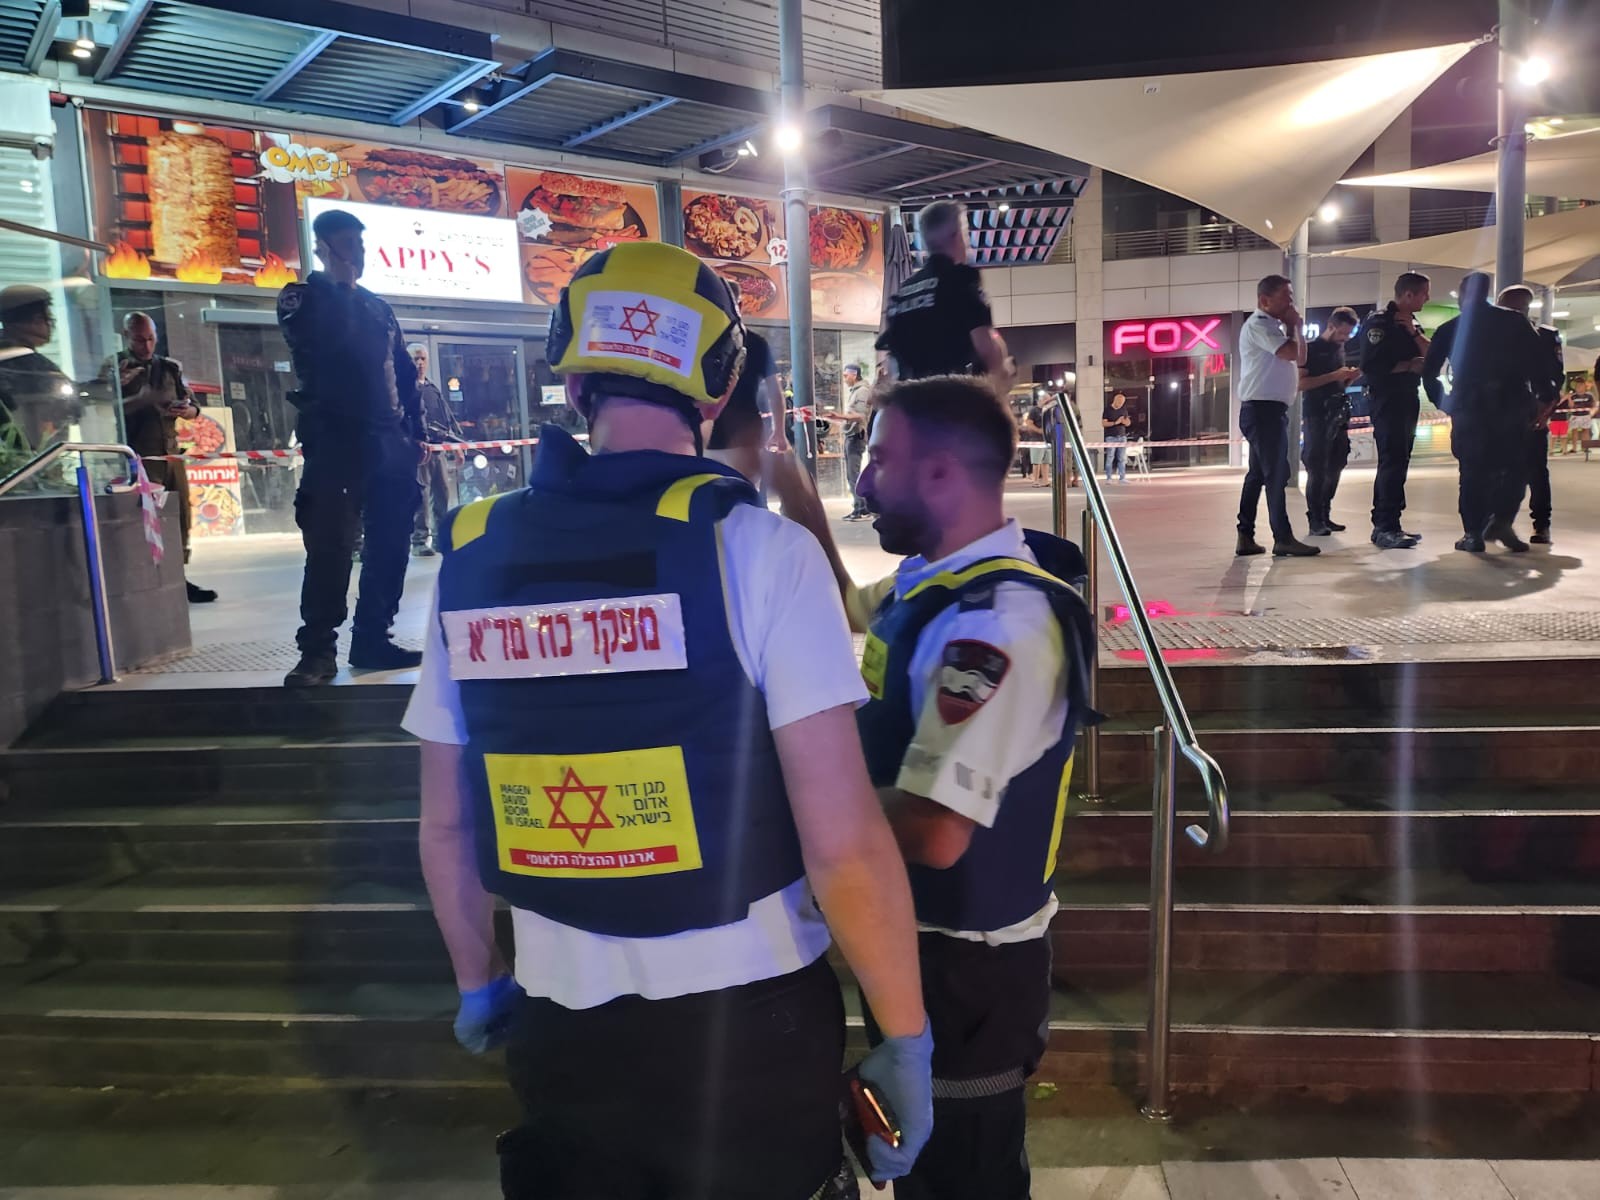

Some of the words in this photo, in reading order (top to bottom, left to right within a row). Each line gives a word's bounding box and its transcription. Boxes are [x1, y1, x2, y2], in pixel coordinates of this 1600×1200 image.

[373, 246, 491, 275] APPY'S
[1114, 319, 1221, 354] FOX
[582, 607, 660, 664] מפקד
[500, 783, 531, 795] MAGEN
[615, 783, 638, 797] דוד
[642, 780, 666, 797] מגן
[501, 793, 528, 806] DAVID
[633, 796, 669, 811] אדום
[515, 817, 545, 829] ISRAEL
[616, 811, 672, 828] בישראל
[525, 853, 569, 866] הלאומי
[570, 854, 616, 867] ההצלה
[619, 850, 656, 868] ארגון
